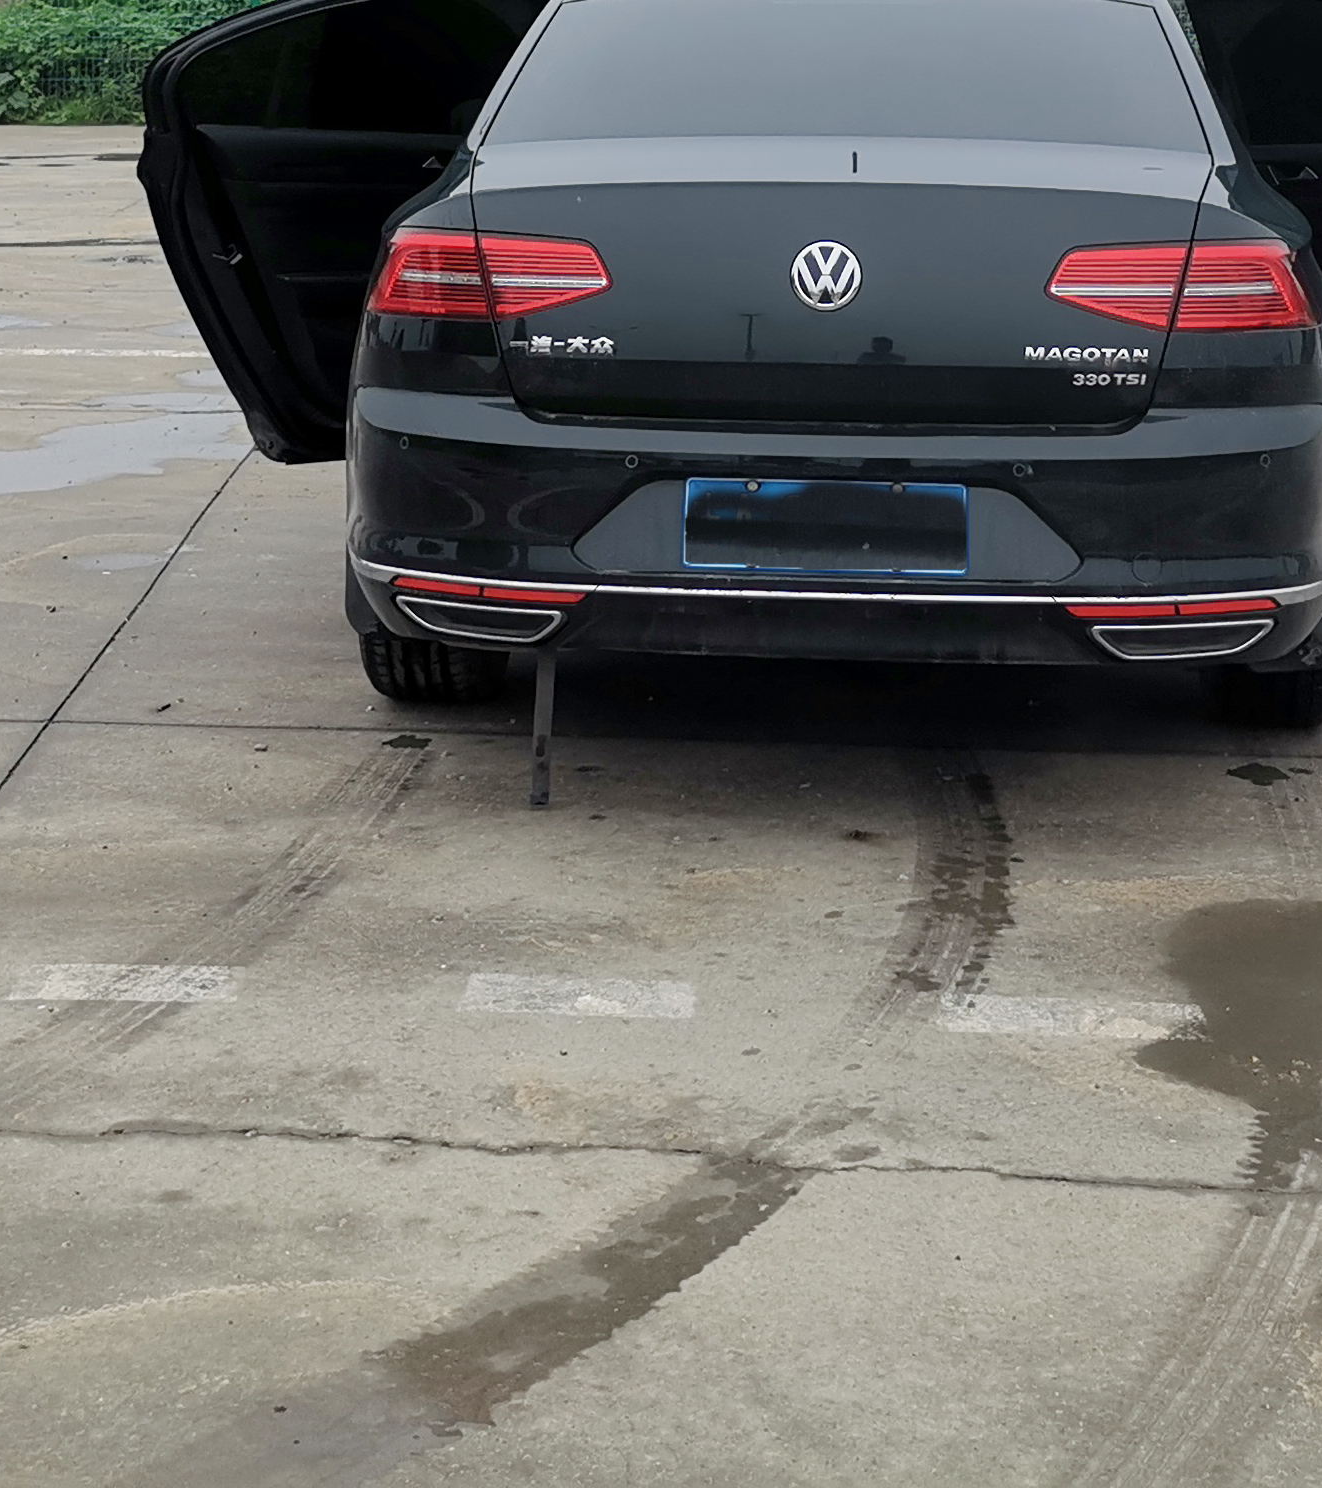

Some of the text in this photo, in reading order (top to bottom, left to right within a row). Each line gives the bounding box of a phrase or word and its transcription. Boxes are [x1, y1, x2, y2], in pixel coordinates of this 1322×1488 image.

[1024, 346, 1149, 363] MAGOTAN
[1072, 373, 1147, 386] 330 TSI
